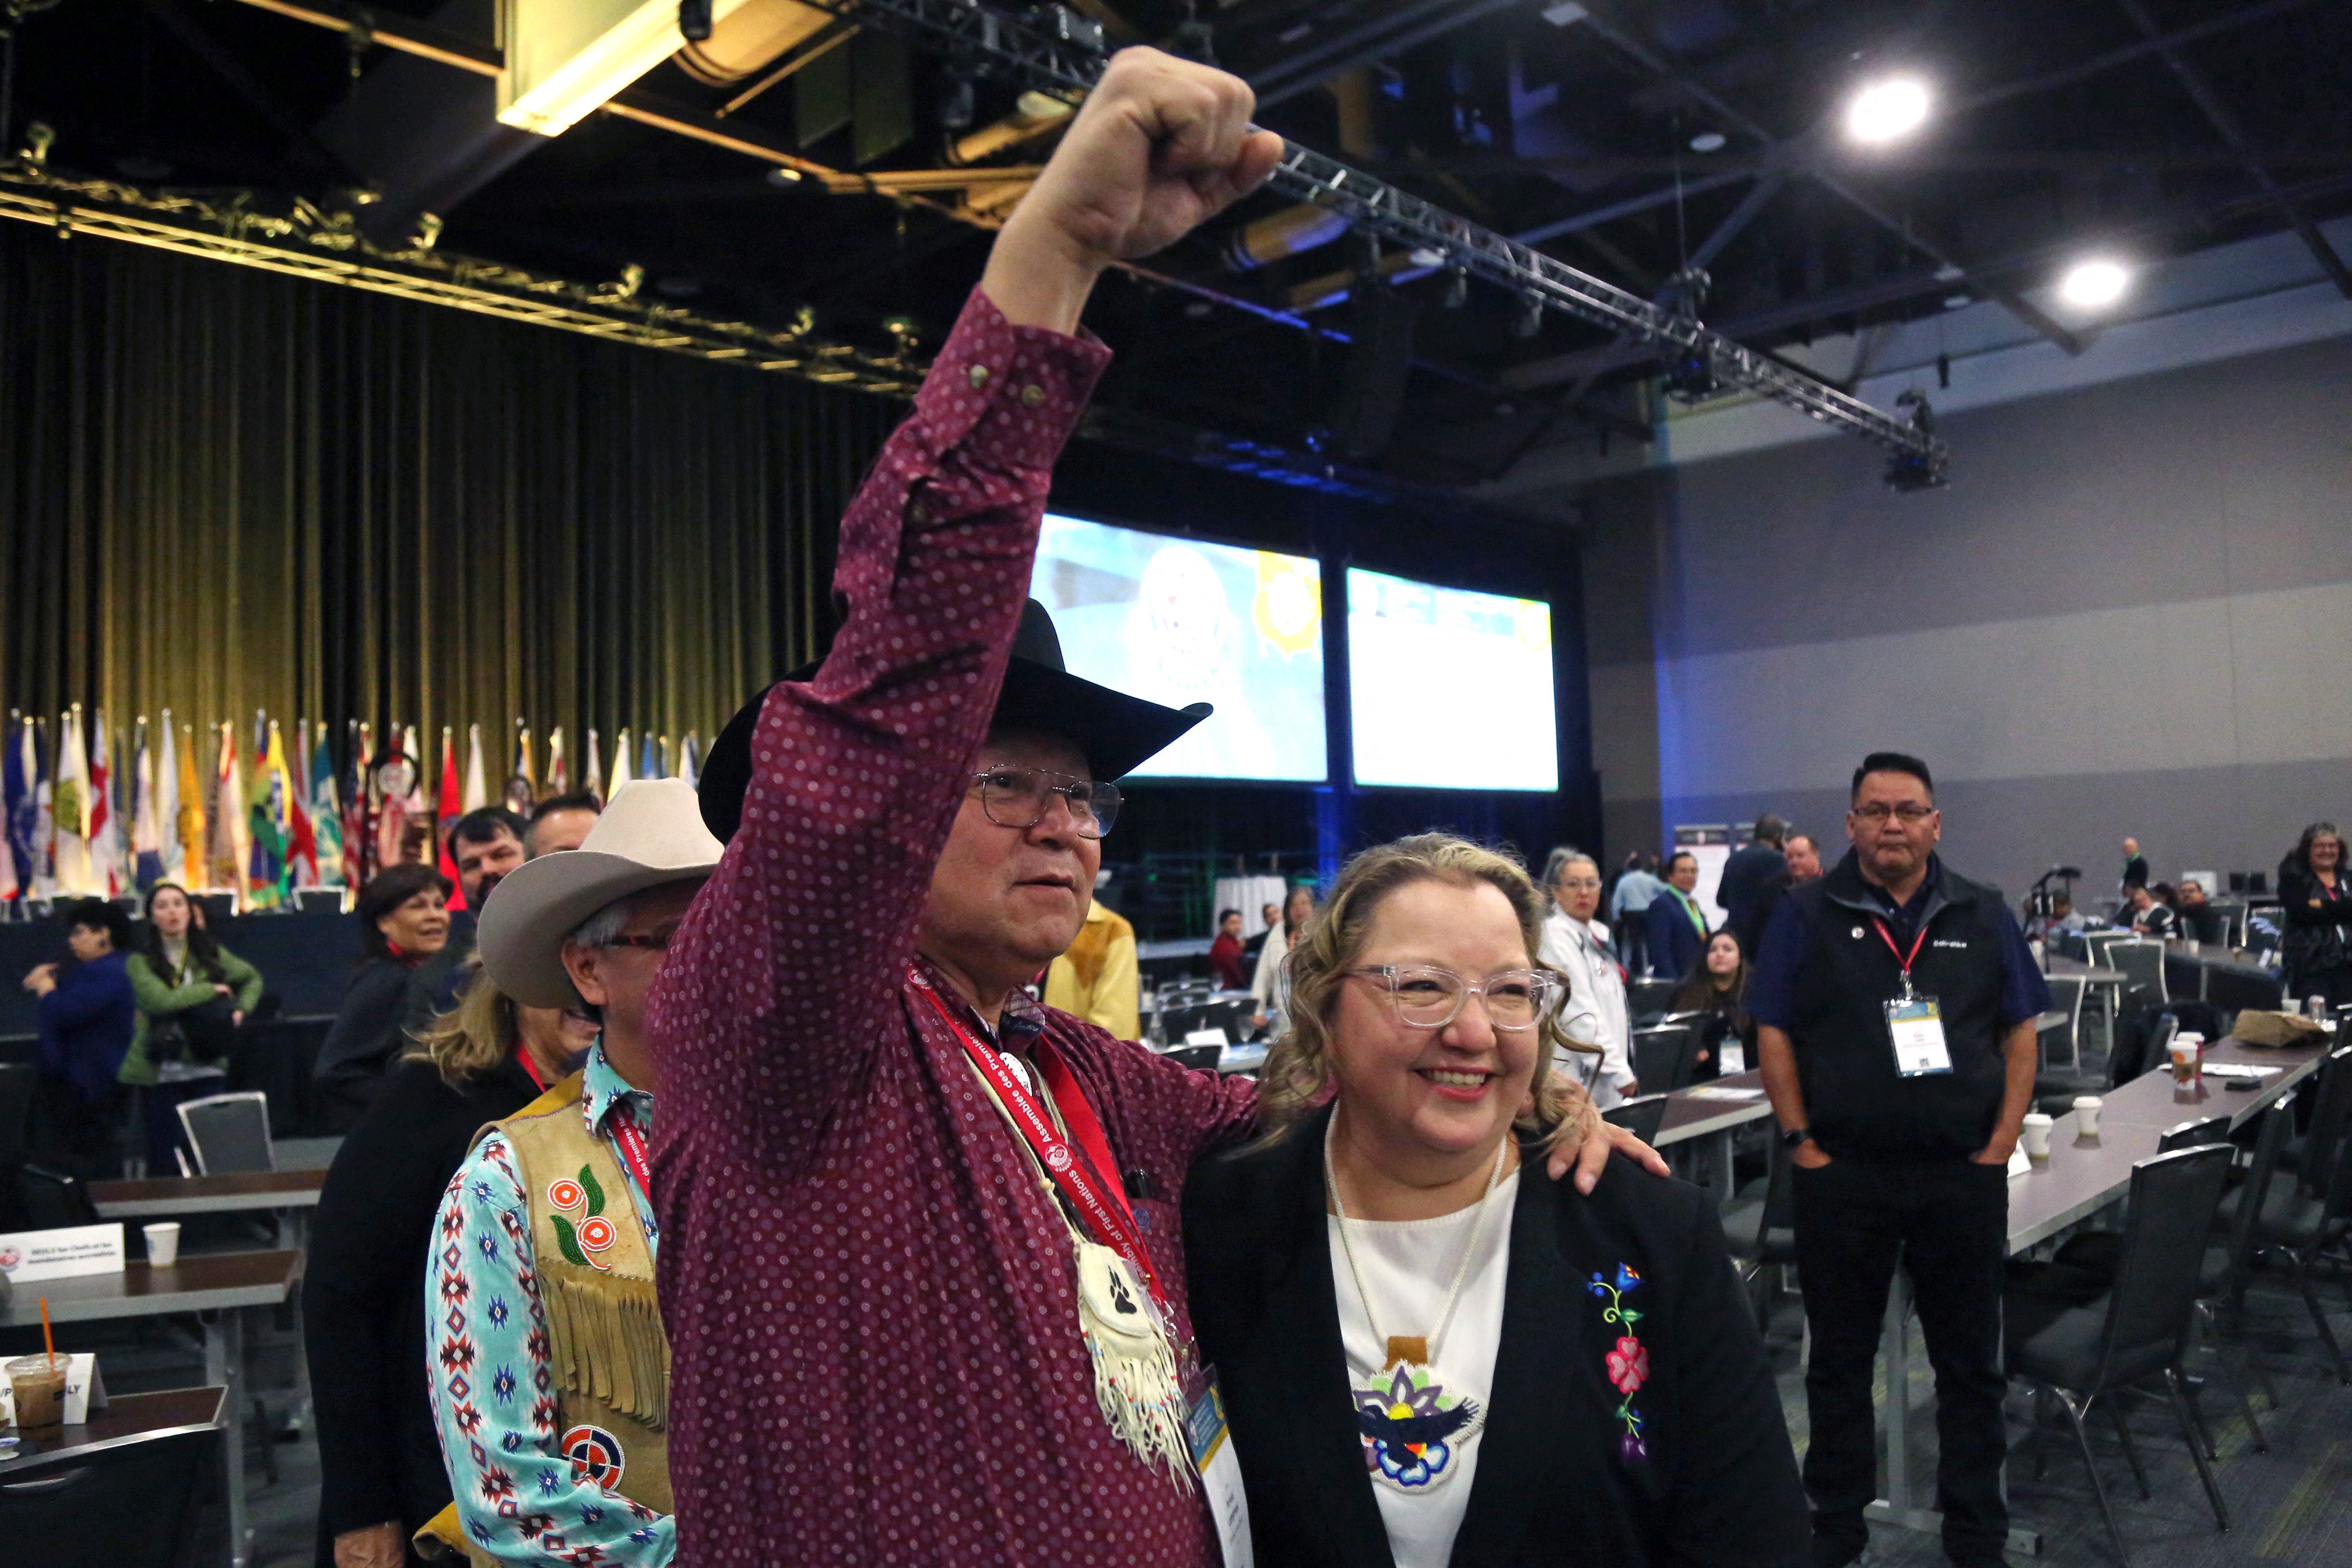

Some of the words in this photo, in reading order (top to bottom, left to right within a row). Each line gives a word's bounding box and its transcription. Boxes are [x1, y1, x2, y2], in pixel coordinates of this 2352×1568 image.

[961, 1026, 1000, 1071] Premières
[997, 1069, 1013, 1089] des
[1012, 1090, 1052, 1143] Assemblée
[640, 1162, 650, 1177] des
[1069, 1169, 1098, 1209] Nations
[1095, 1207, 1115, 1232] First
[1111, 1230, 1123, 1241] of
